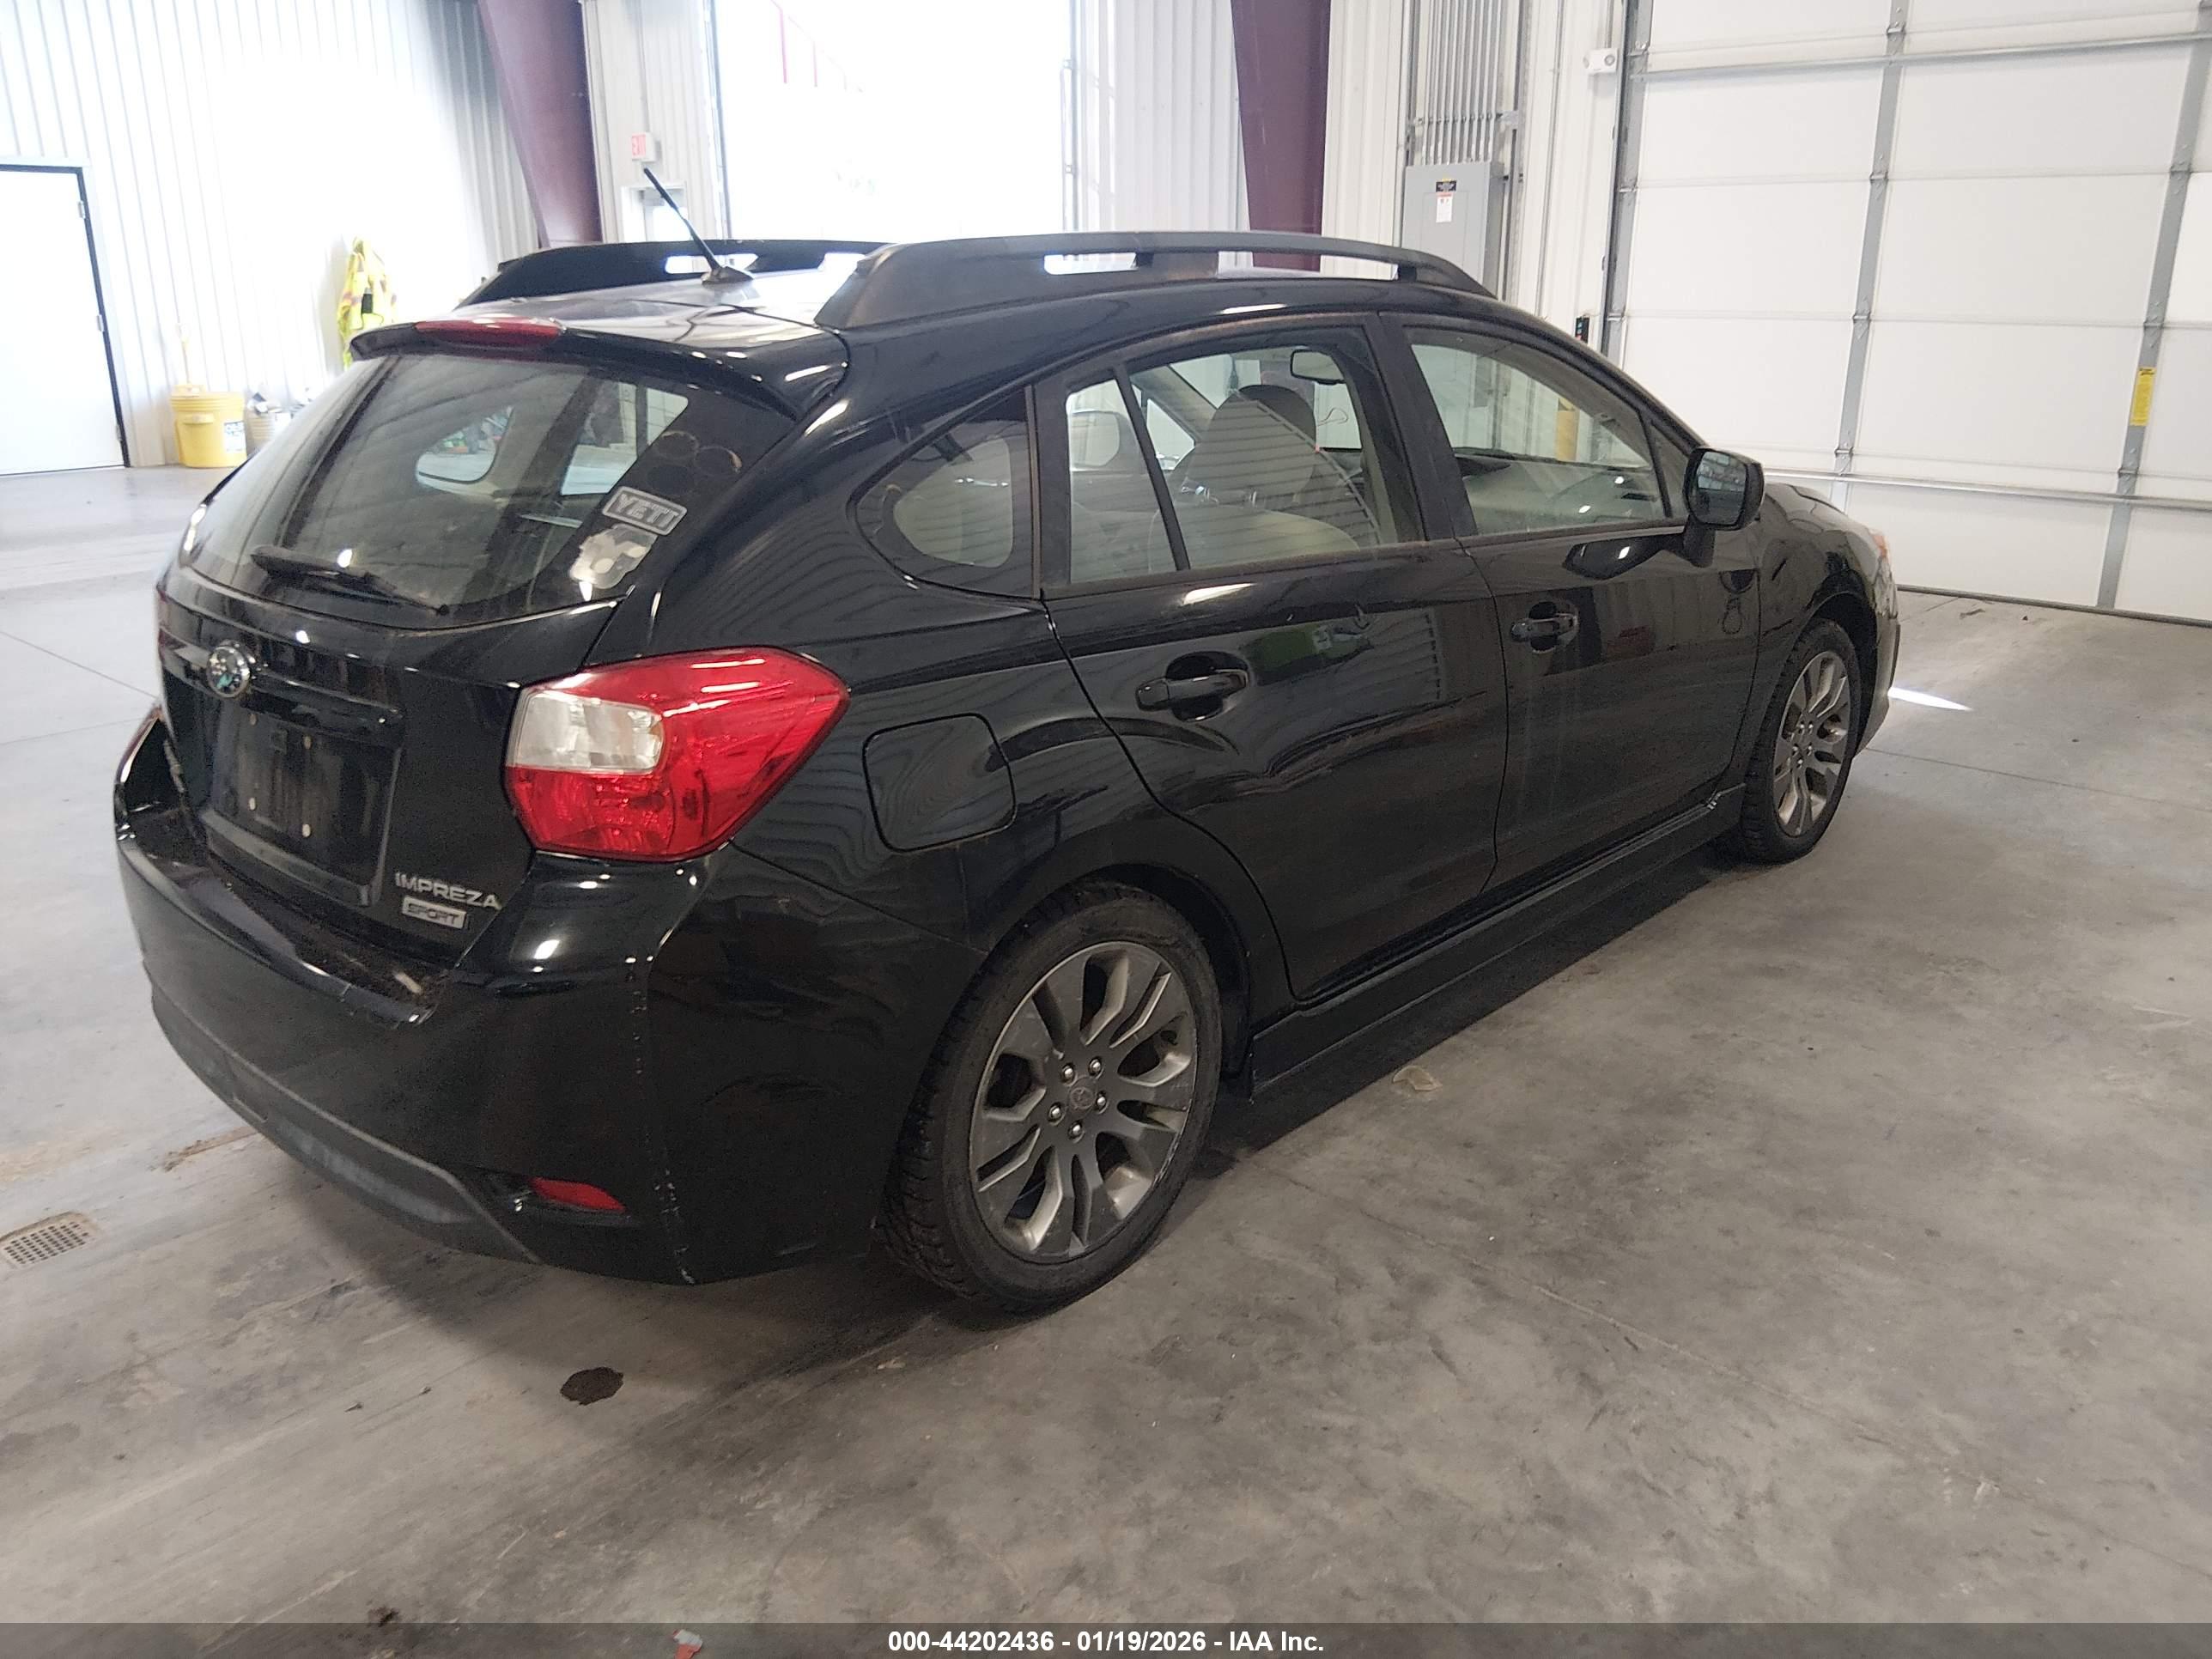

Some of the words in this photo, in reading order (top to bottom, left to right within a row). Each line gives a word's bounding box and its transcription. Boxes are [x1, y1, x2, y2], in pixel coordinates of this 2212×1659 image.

[617, 493, 679, 527] YETI
[395, 872, 502, 910] IMPREZA
[407, 902, 461, 925] SPORT
